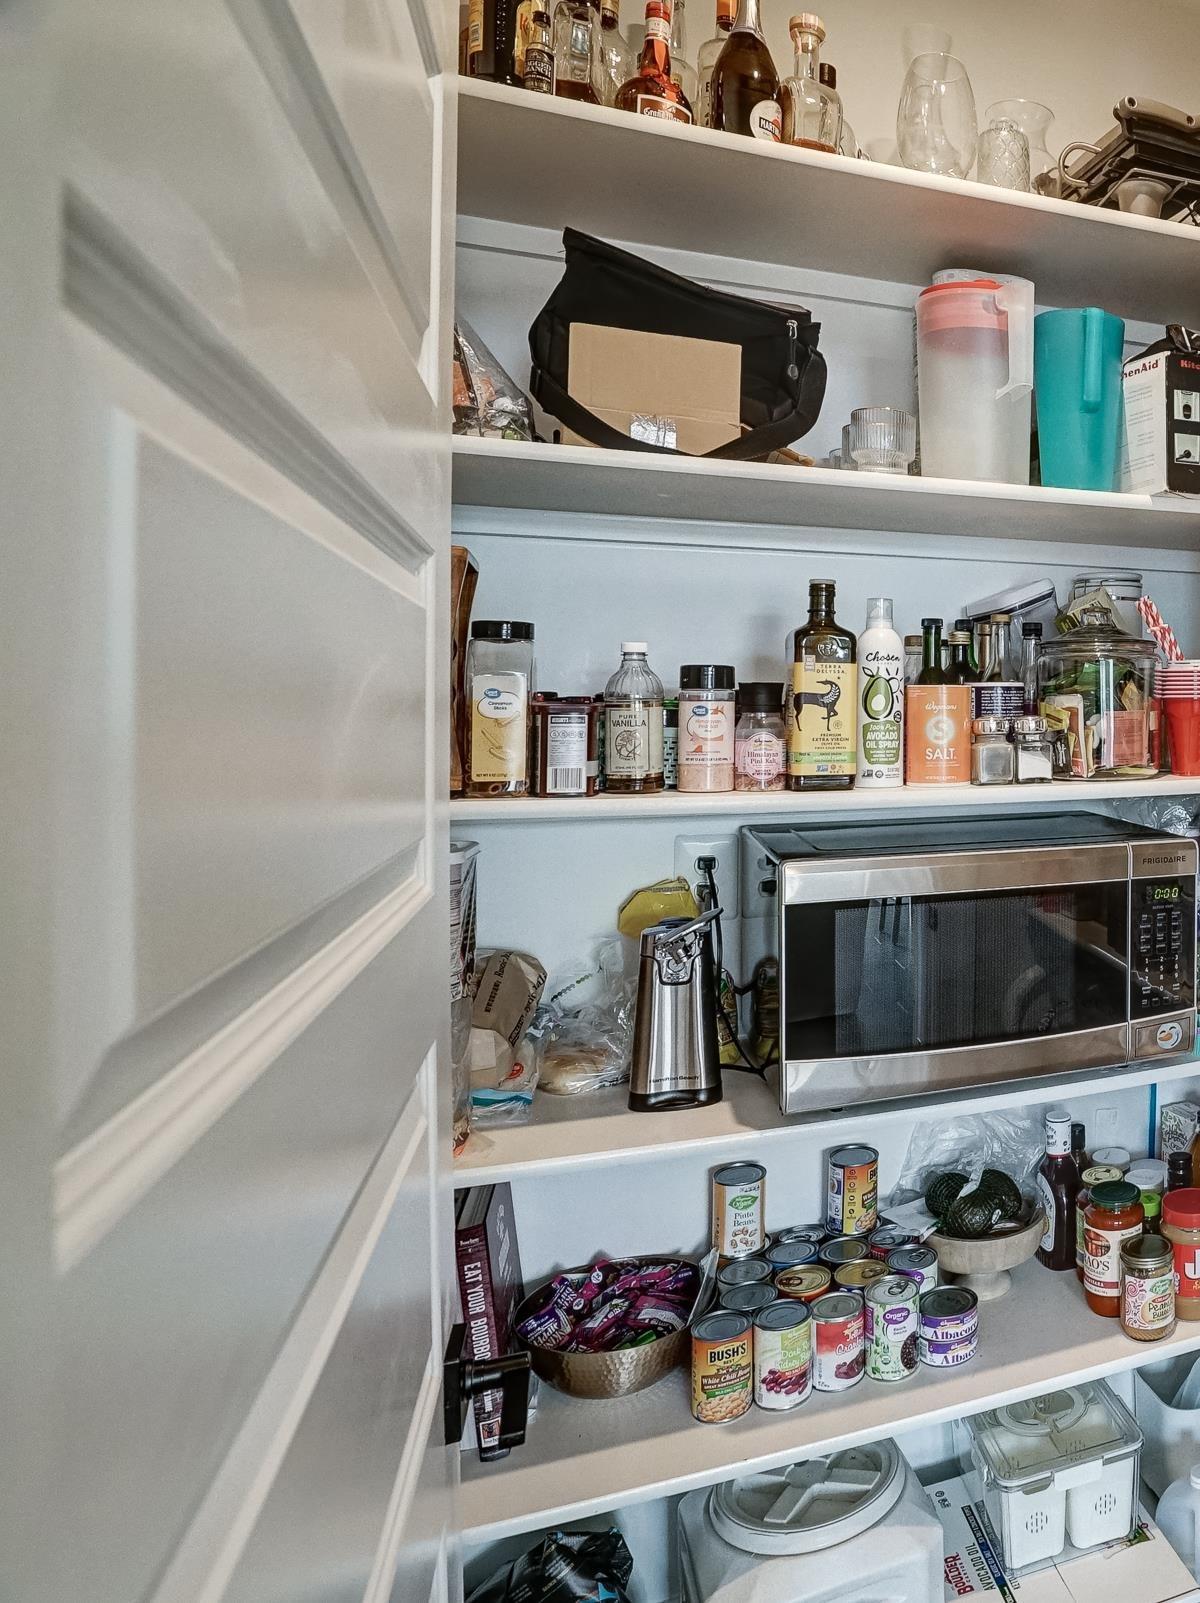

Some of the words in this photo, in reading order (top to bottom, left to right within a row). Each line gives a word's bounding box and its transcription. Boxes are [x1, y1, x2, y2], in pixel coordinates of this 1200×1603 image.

[865, 650, 900, 662] Chosen
[611, 719, 647, 728] VANILLA
[866, 731, 898, 740] AVOCADO
[866, 741, 877, 749] OIL
[878, 740, 899, 749] SPRAY
[747, 751, 778, 759] Himalayan
[925, 748, 956, 760] SALT
[1142, 855, 1186, 865] FRIGIDAIRE
[1154, 887, 1179, 900] 0:00
[734, 1212, 754, 1220] Pinto
[733, 1219, 755, 1227] Beans
[464, 1261, 481, 1283] EAT
[466, 1285, 485, 1315] YOUR
[885, 1311, 909, 1320] Organic
[470, 1317, 491, 1361] BOURBO
[709, 1343, 746, 1363] BUSH'S
[781, 1350, 799, 1359] Dark
[702, 1376, 720, 1385] White
[721, 1372, 737, 1382] Chili
[965, 1542, 978, 1557] OIL
[944, 1552, 974, 1596] BOULDER
[971, 1557, 997, 1591] AVOCADO
